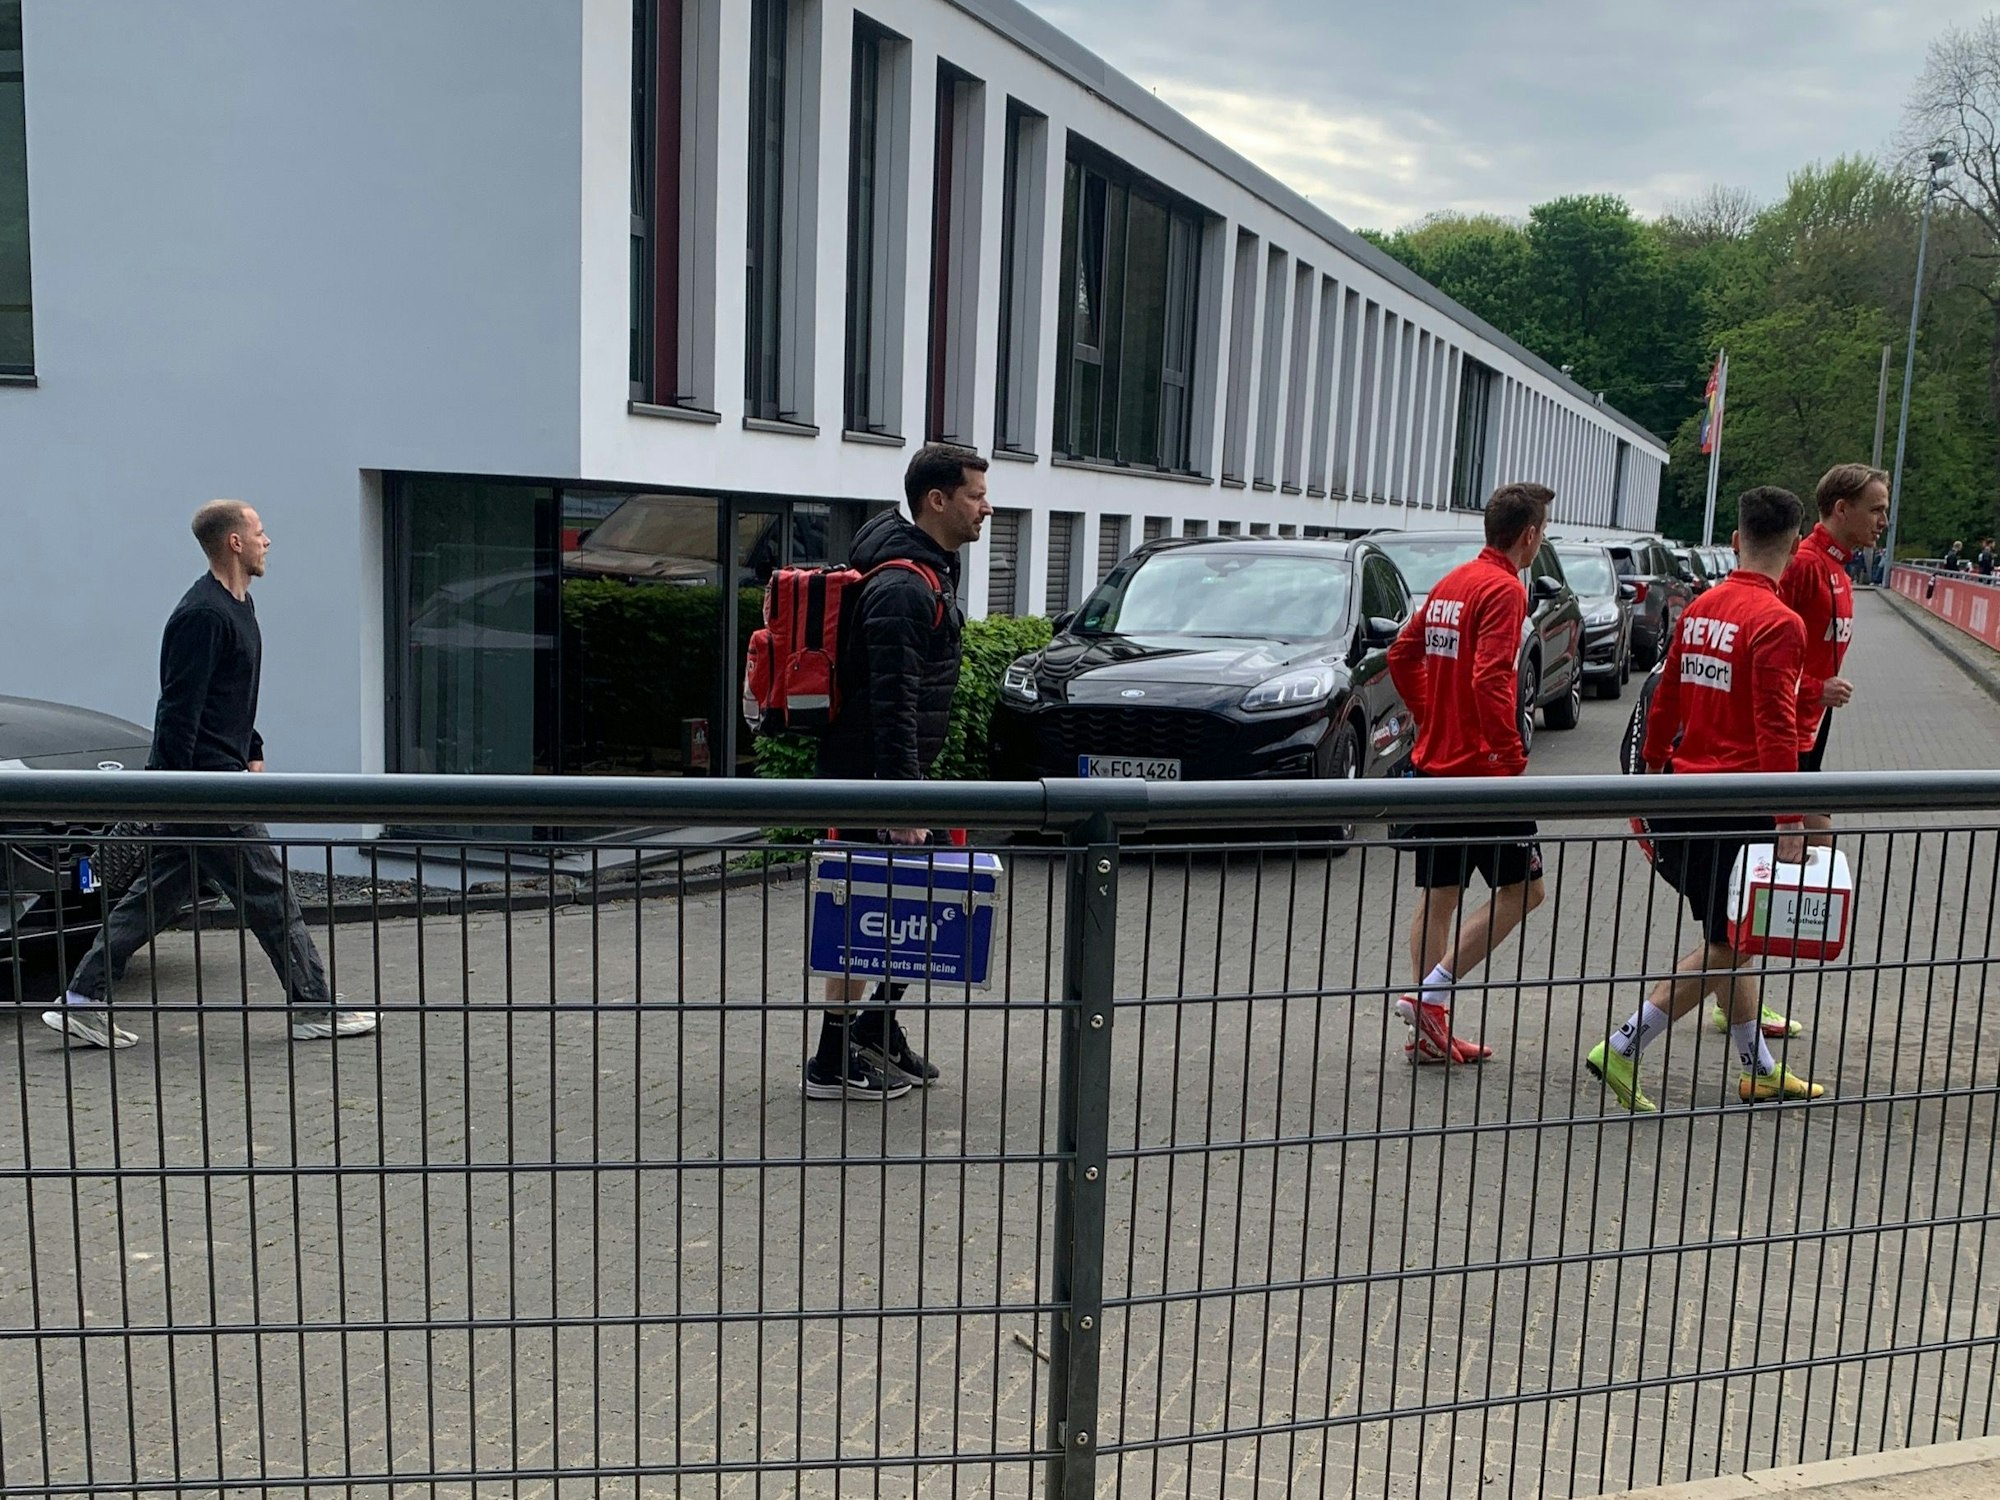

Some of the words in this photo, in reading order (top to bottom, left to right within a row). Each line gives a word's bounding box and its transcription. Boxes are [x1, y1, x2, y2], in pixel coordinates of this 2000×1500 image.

[1682, 616, 1739, 654] REWE
[1090, 760, 1099, 776] K
[1111, 761, 1132, 777] FC
[1136, 762, 1177, 779] 1426
[860, 911, 938, 945] Elyth
[871, 957, 881, 968] &
[881, 958, 912, 971] sorts
